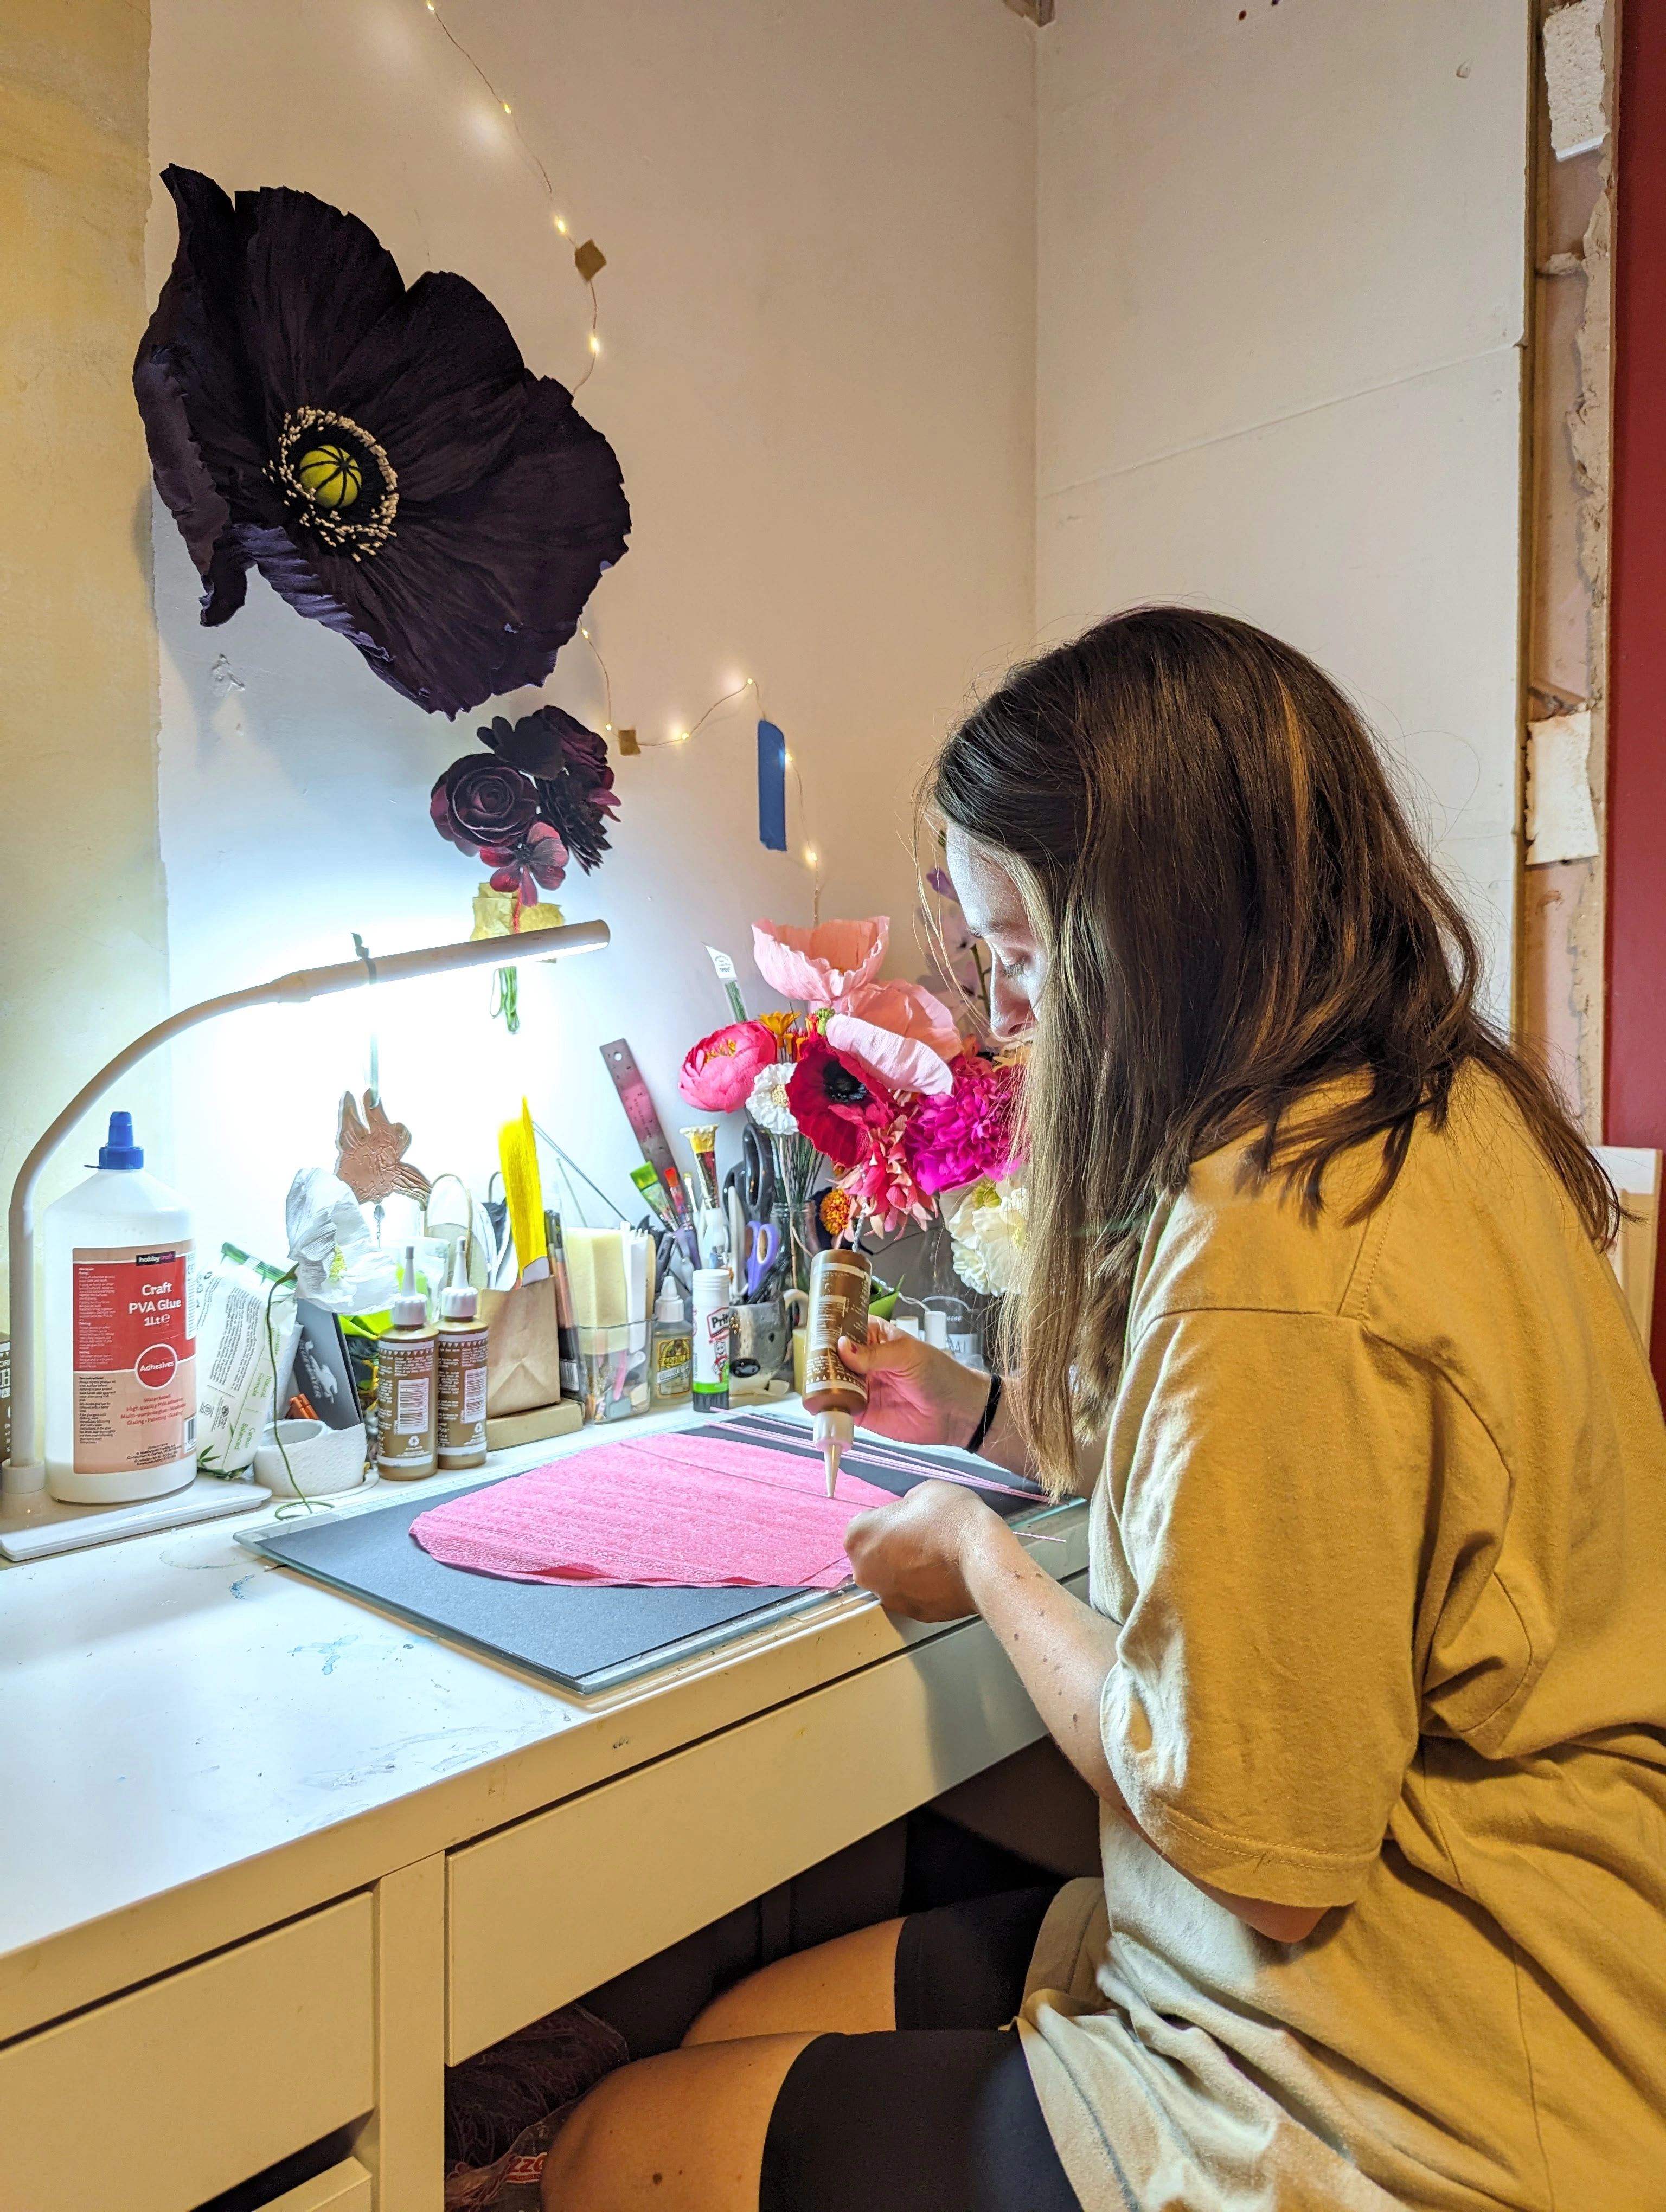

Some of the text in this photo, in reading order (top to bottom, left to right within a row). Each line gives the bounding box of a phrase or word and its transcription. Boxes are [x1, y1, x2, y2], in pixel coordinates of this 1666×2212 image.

[138, 1253, 174, 1263] hobbycraft
[142, 1282, 172, 1296] Craft
[129, 1298, 181, 1314] PVA Glue
[139, 1361, 174, 1372] Adhesives
[252, 1373, 265, 1397] Formula
[260, 1375, 272, 1397] Natural
[120, 1411, 158, 1419] Multi-purpose
[234, 1423, 248, 1450] Balanced
[244, 1427, 256, 1449] Carbon
